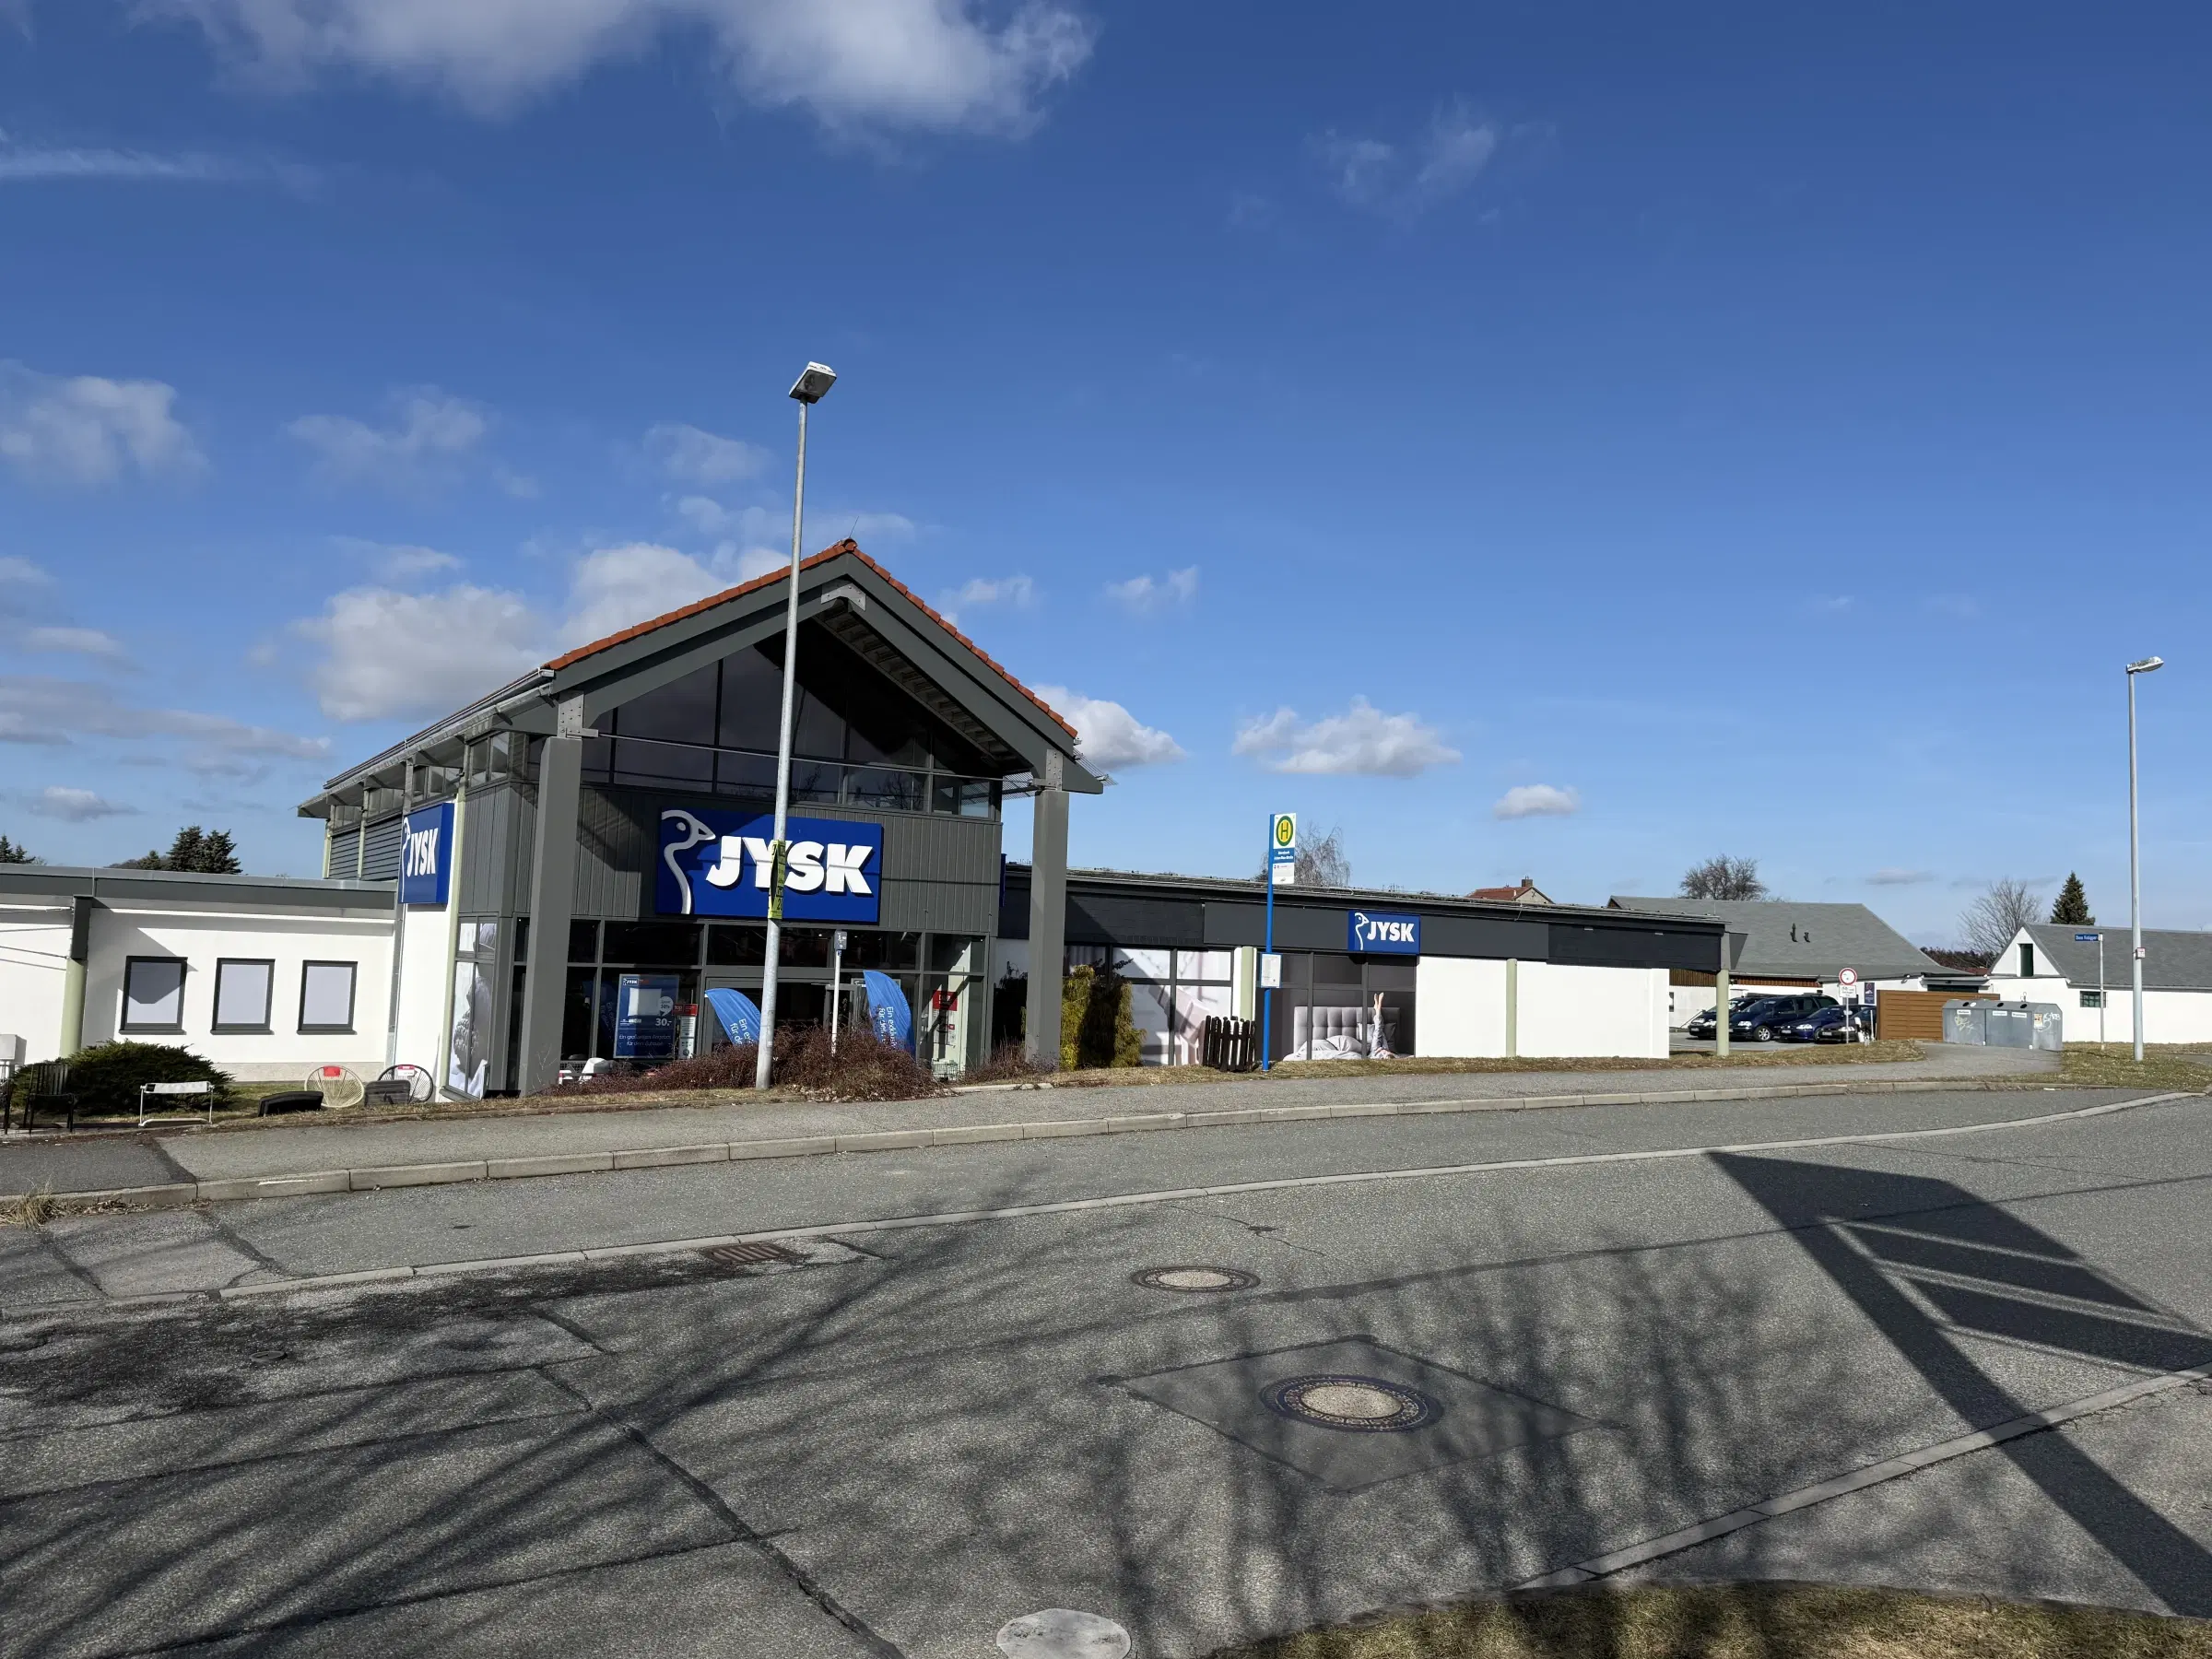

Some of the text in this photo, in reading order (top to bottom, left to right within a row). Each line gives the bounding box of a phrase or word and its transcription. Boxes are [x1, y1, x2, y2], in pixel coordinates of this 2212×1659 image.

[1281, 822, 1288, 840] H
[406, 827, 440, 877] JYSK
[706, 835, 874, 895] JYSK
[1367, 921, 1415, 942] JYSK
[730, 1022, 739, 1034] für
[739, 1018, 747, 1031] Ein
